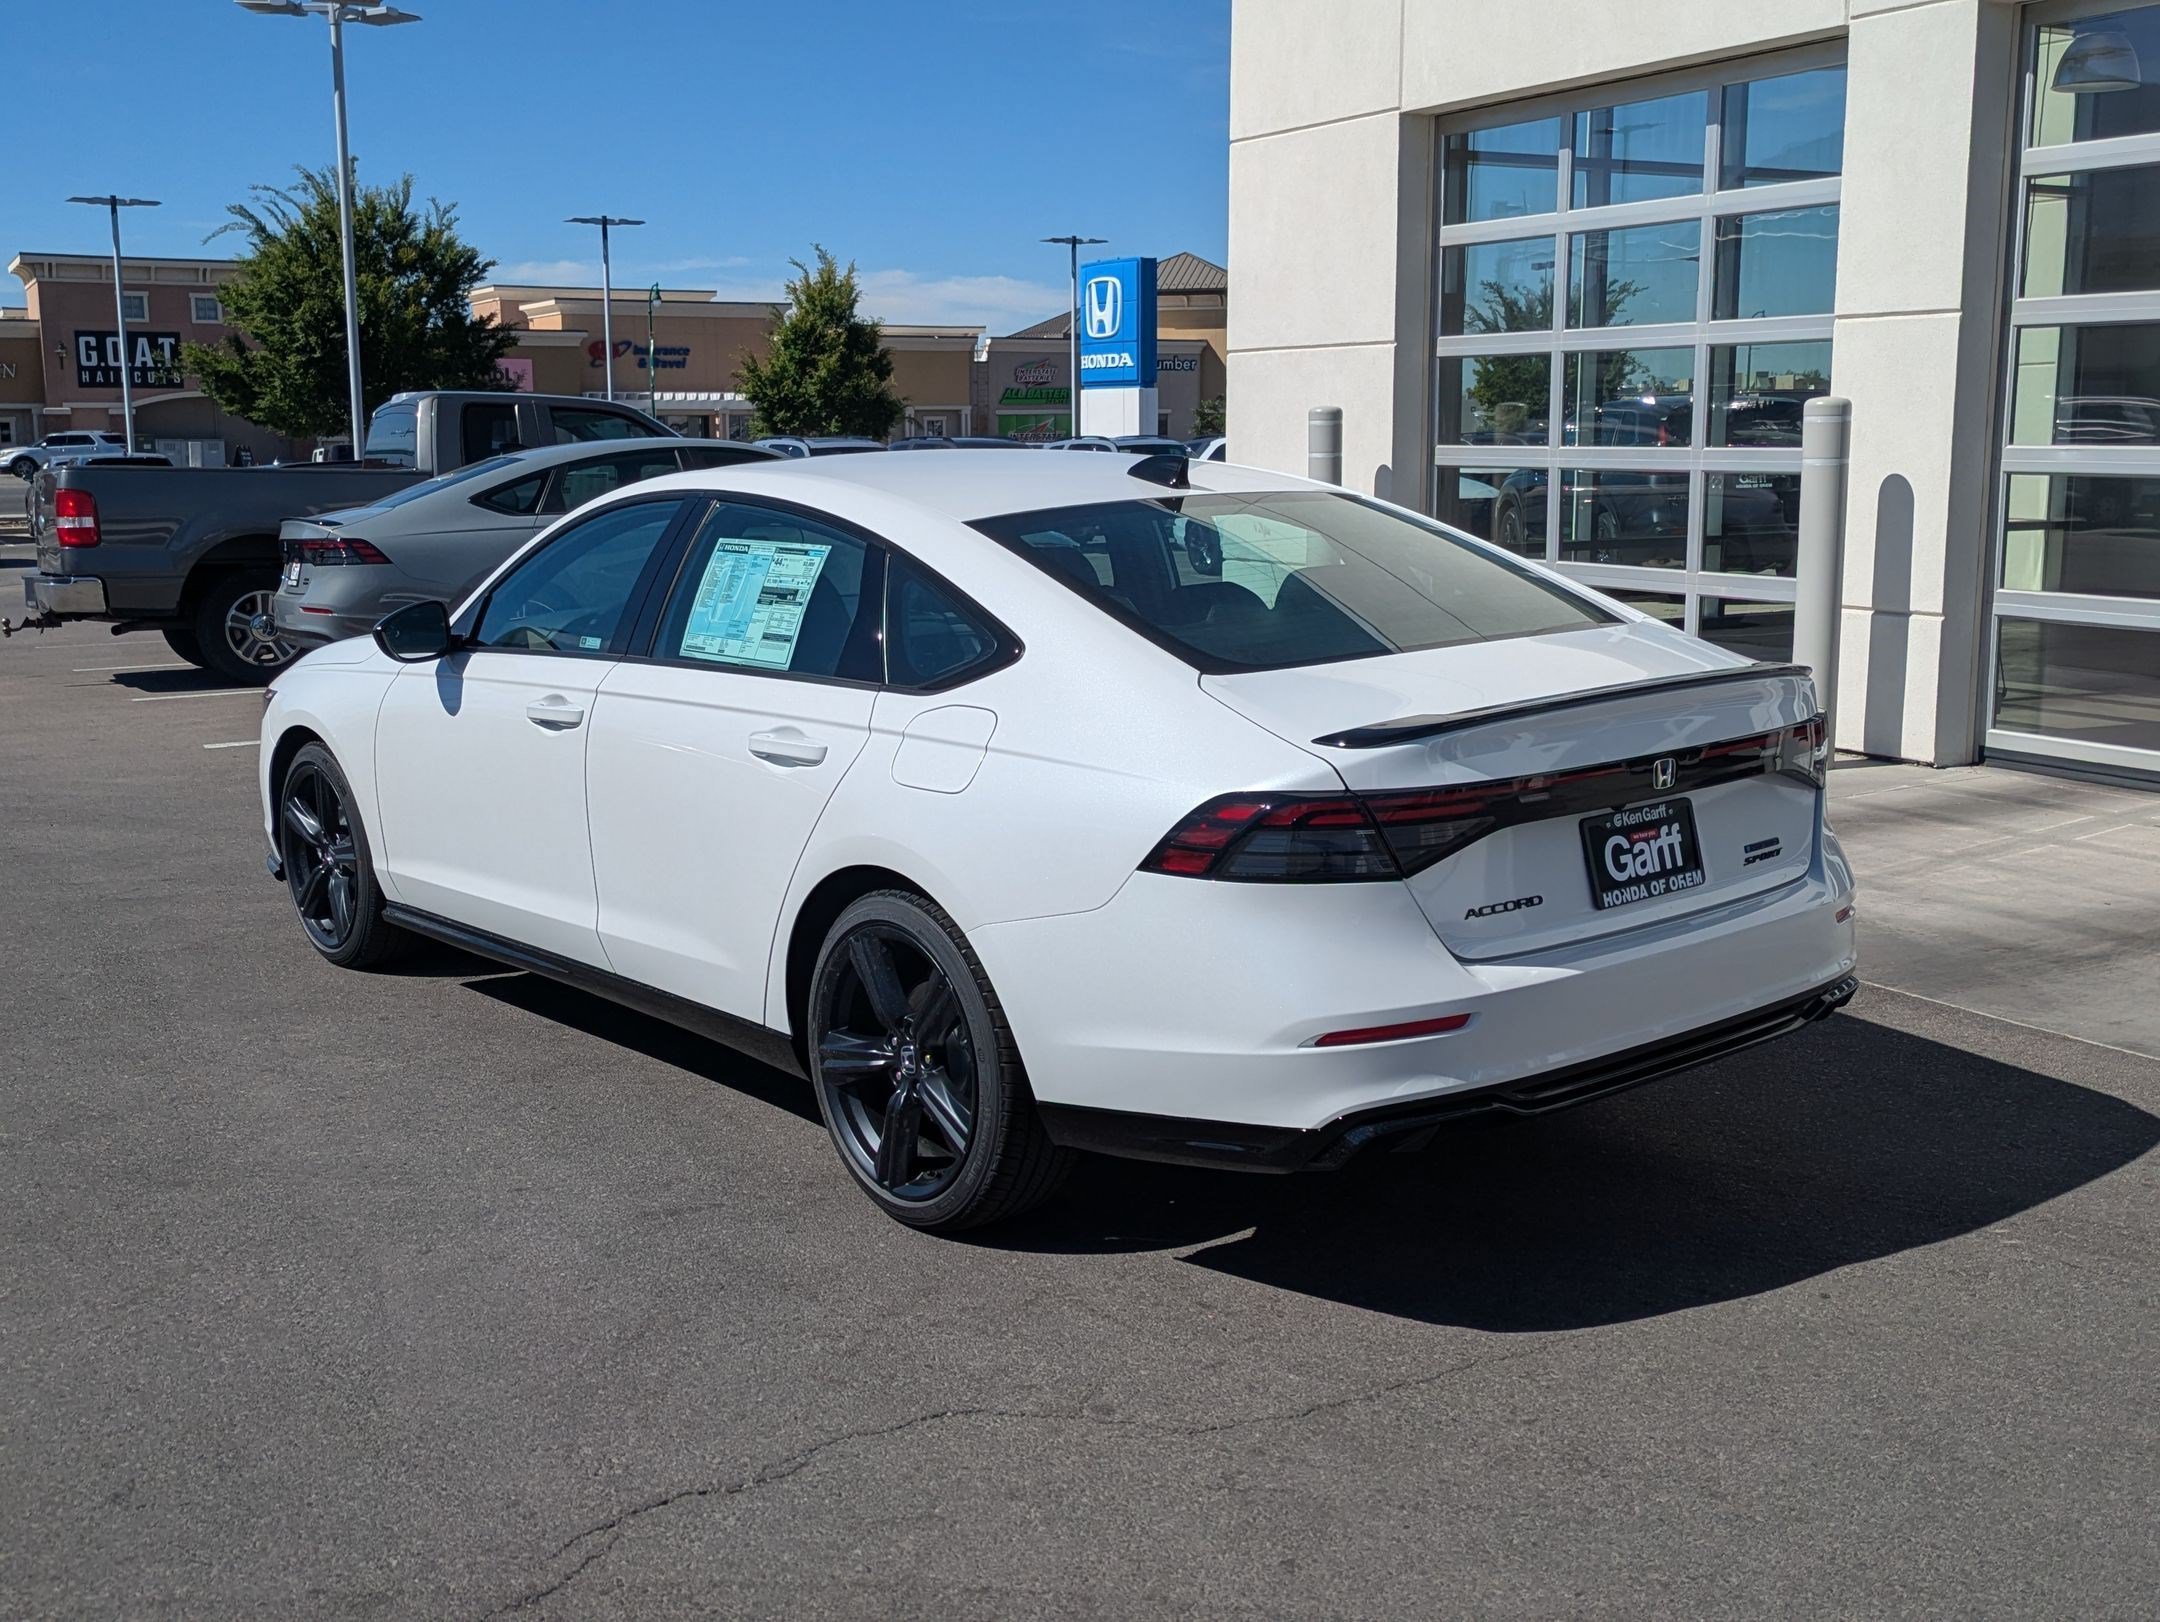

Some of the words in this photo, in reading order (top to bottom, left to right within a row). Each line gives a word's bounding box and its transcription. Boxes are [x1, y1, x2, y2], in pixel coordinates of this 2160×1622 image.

[1081, 353, 1134, 369] HONDA
[1016, 368, 1058, 376] INTERSTATE
[724, 544, 749, 552] HONDA
[1604, 822, 1683, 881] Garff
[1743, 847, 1783, 867] SPORT
[1603, 883, 1648, 908] HONDA
[1650, 879, 1667, 895] OF
[1669, 870, 1703, 891] OREM
[1464, 895, 1544, 921] ACCORD
